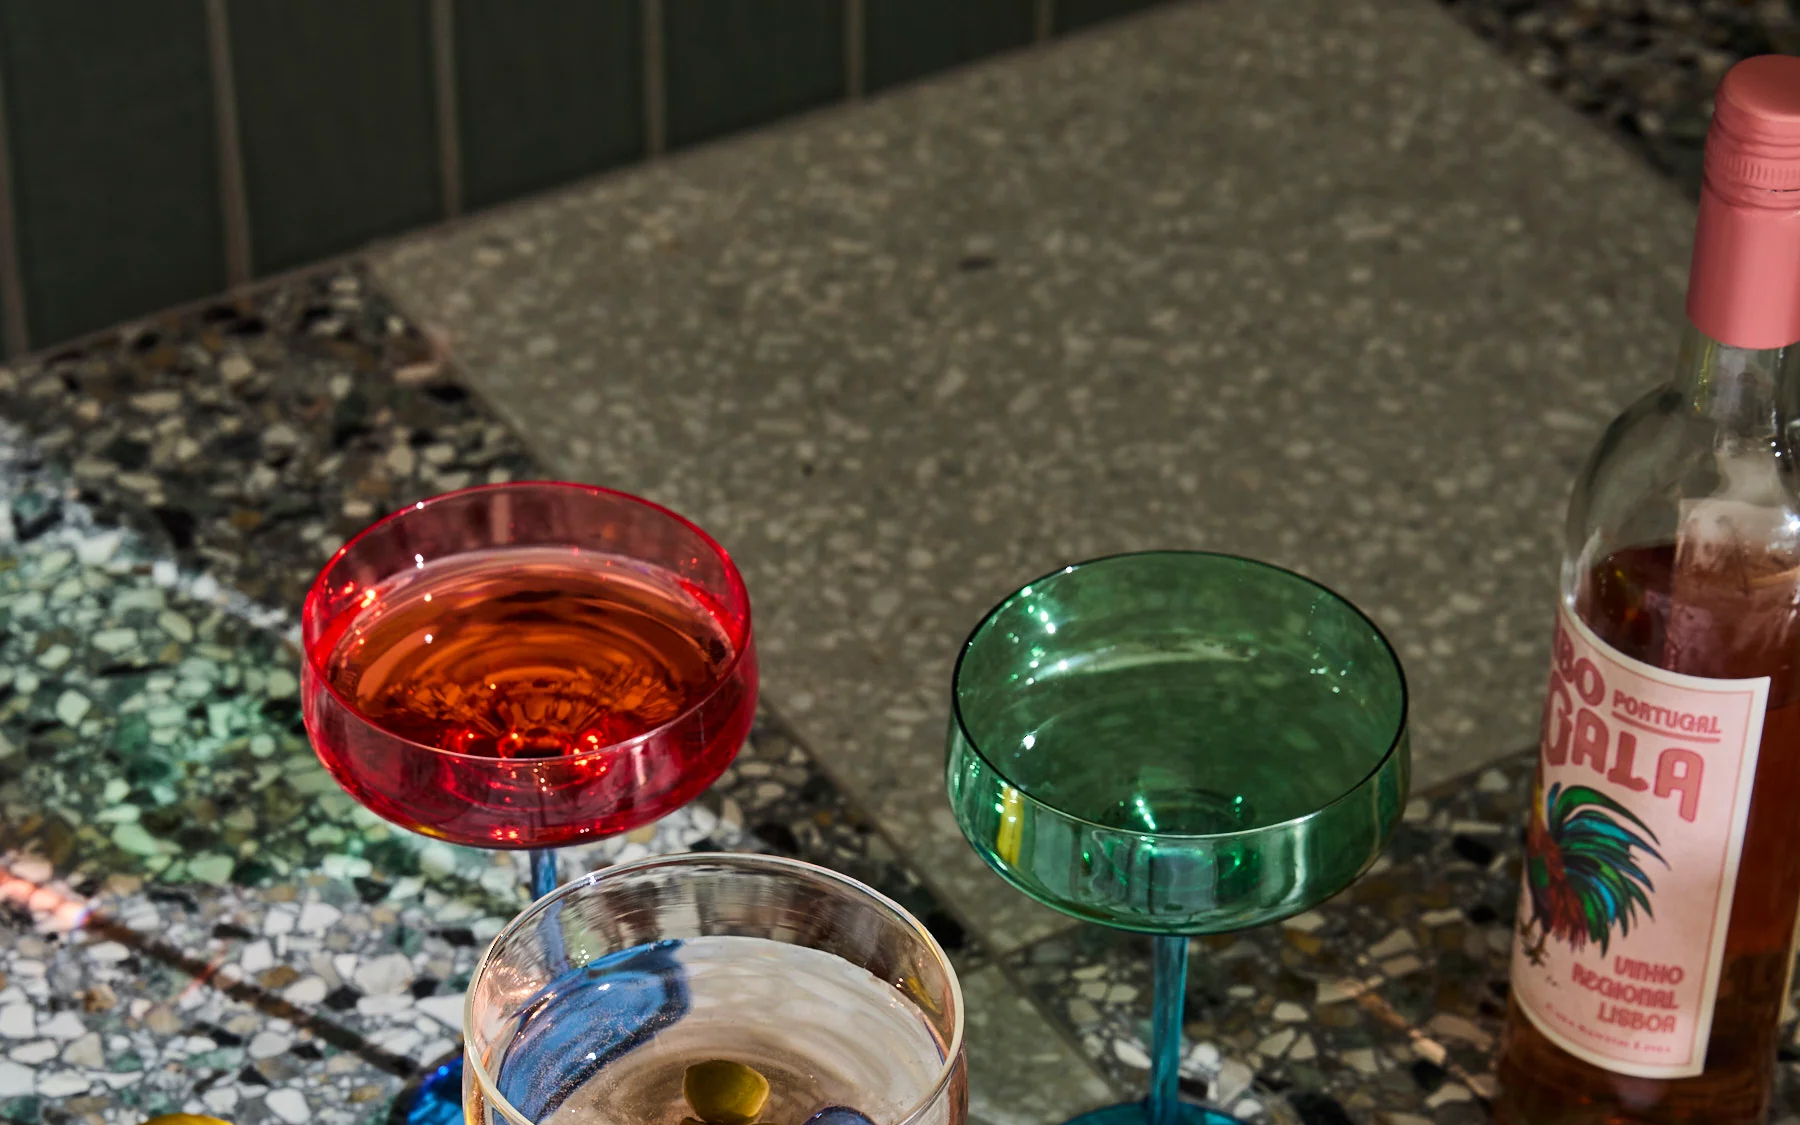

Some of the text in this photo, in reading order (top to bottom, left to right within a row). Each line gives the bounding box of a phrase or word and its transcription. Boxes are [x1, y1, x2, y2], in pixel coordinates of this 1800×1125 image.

[1612, 689, 1722, 735] PORTUGAL
[1571, 962, 1680, 1010] REGIONAL
[1614, 955, 1685, 985] VINHO
[1597, 1003, 1677, 1033] LISBOA
